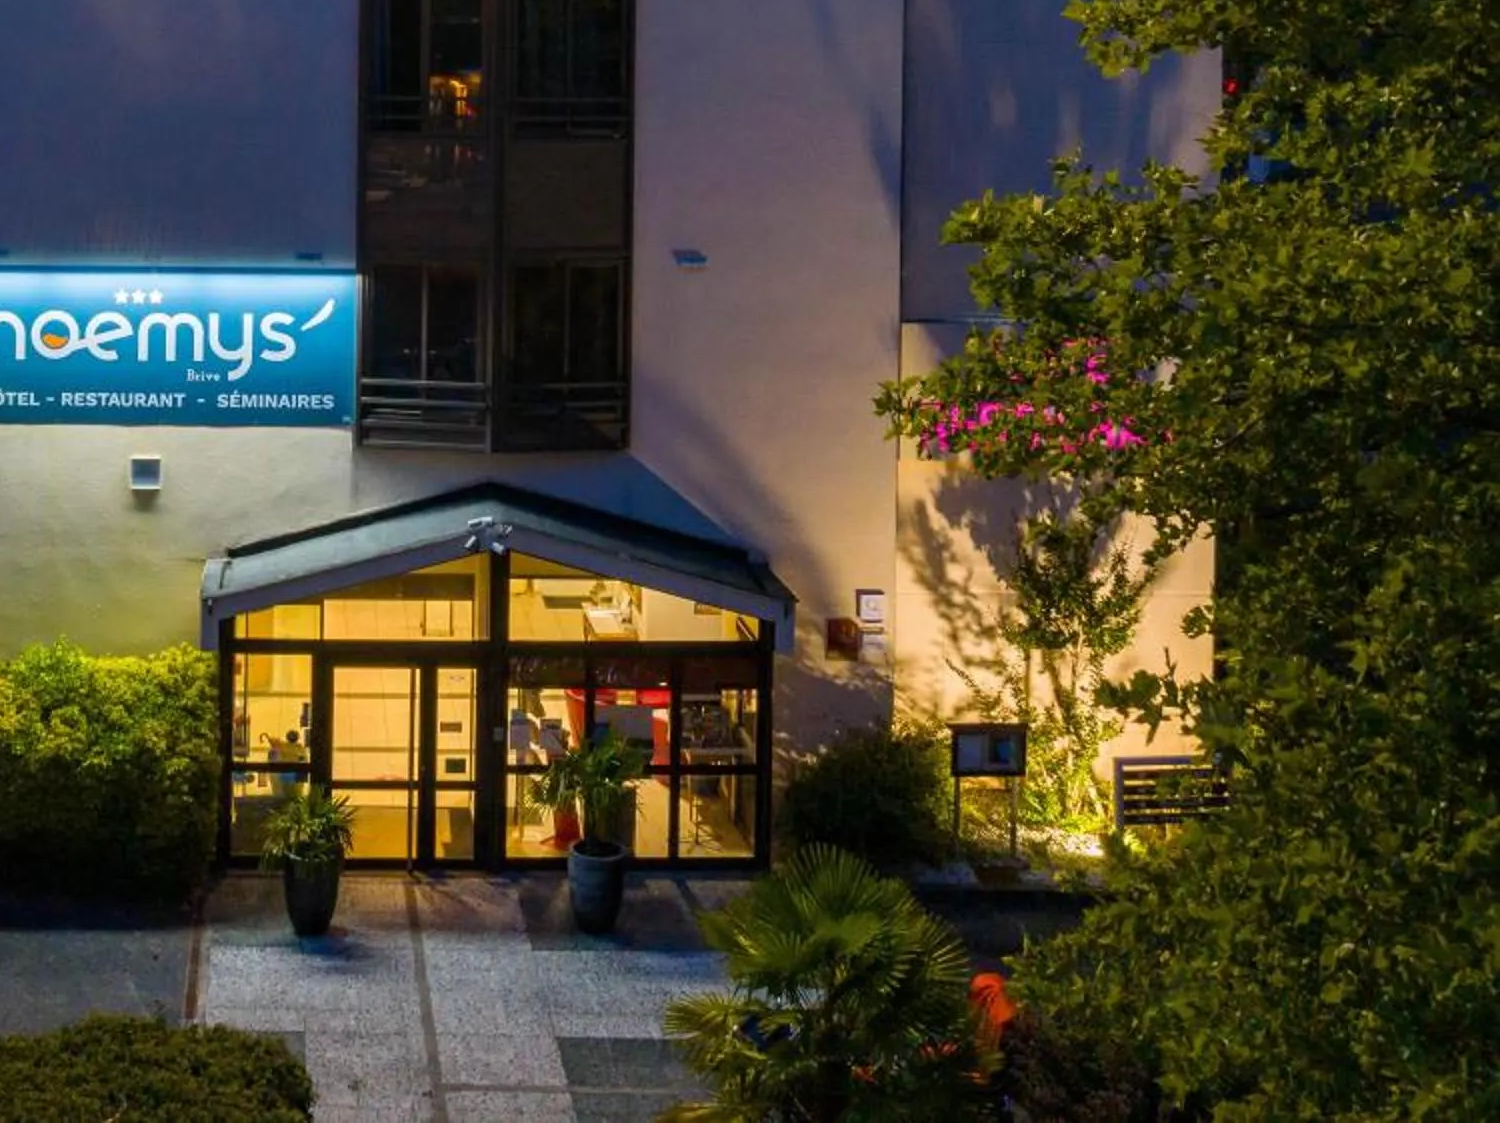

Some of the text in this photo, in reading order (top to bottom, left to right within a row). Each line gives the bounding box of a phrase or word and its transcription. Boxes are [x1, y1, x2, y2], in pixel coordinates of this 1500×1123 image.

[186, 368, 221, 382] Brive
[60, 391, 187, 409] RESTAURANT
[216, 388, 335, 409] SÉMINAIRES
